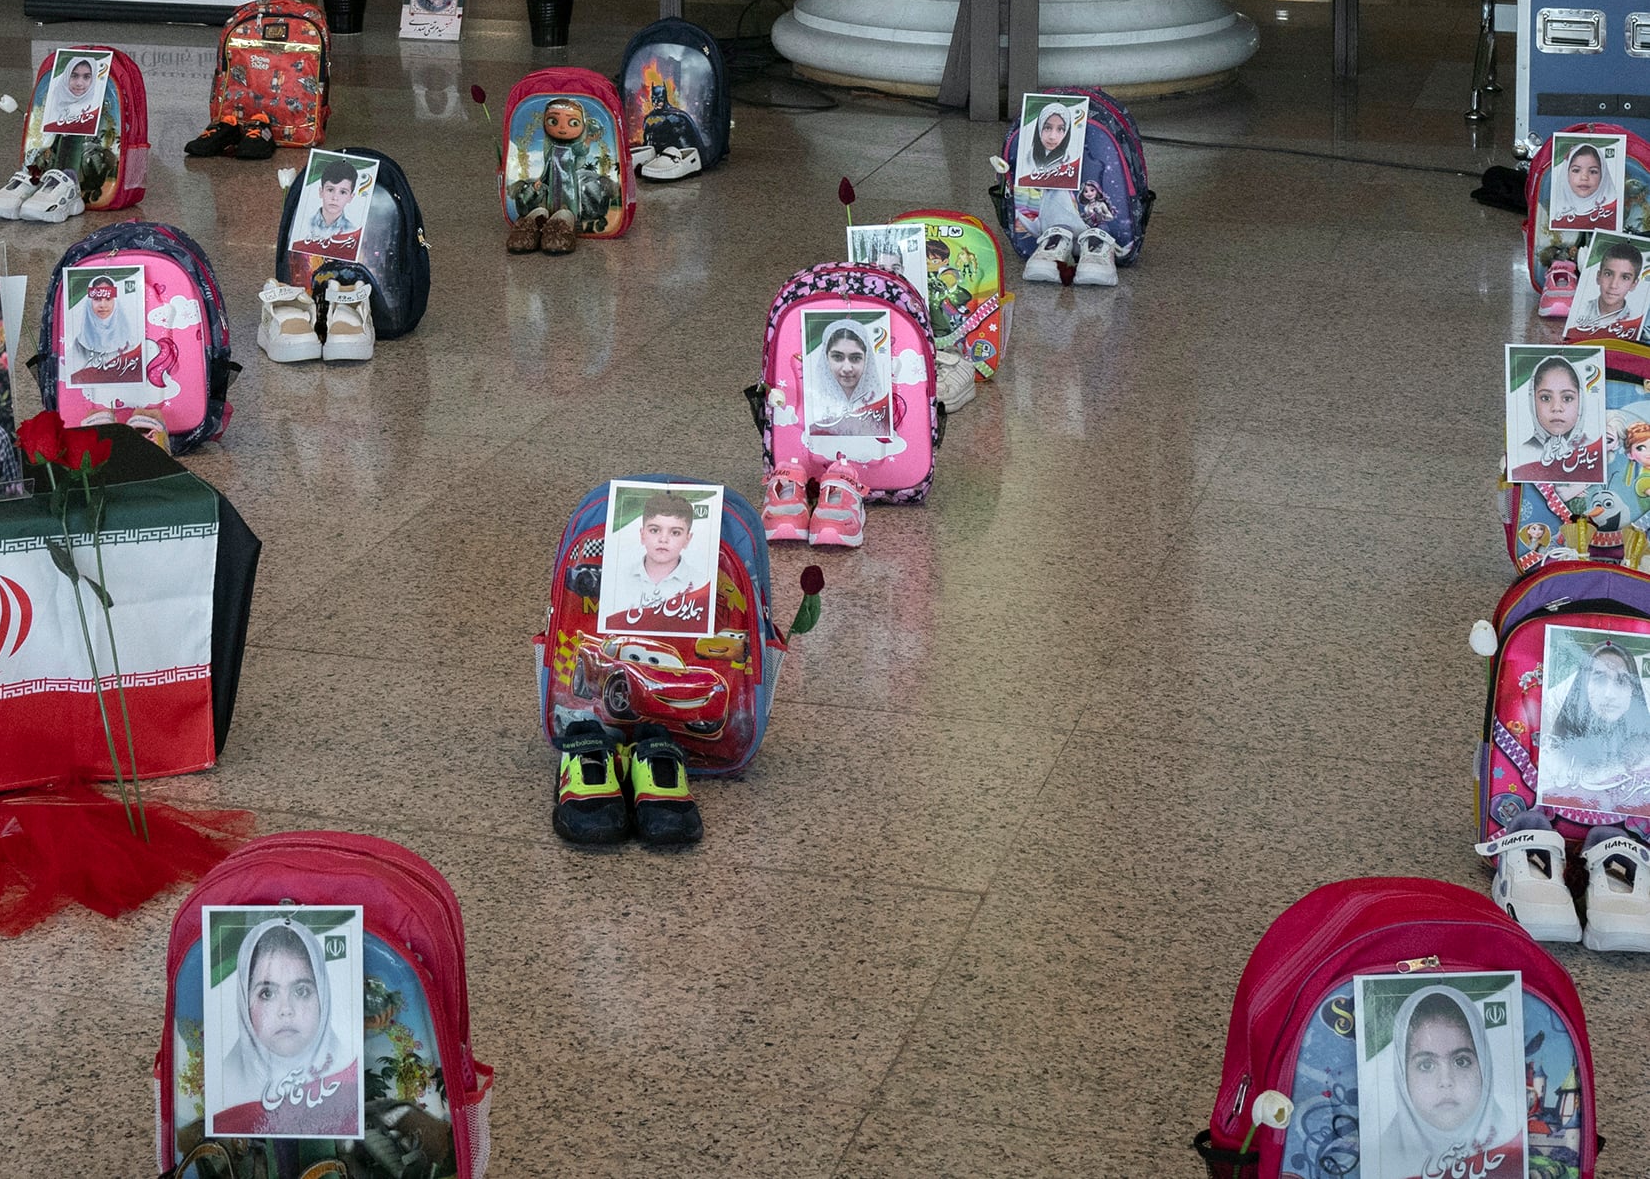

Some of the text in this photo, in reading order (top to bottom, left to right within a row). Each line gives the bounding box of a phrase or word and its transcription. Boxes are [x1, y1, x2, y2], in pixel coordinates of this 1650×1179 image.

[1501, 833, 1535, 848] HAMTA
[1604, 839, 1639, 854] HAMTA
[261, 1068, 343, 1111] حلما قاسمی
